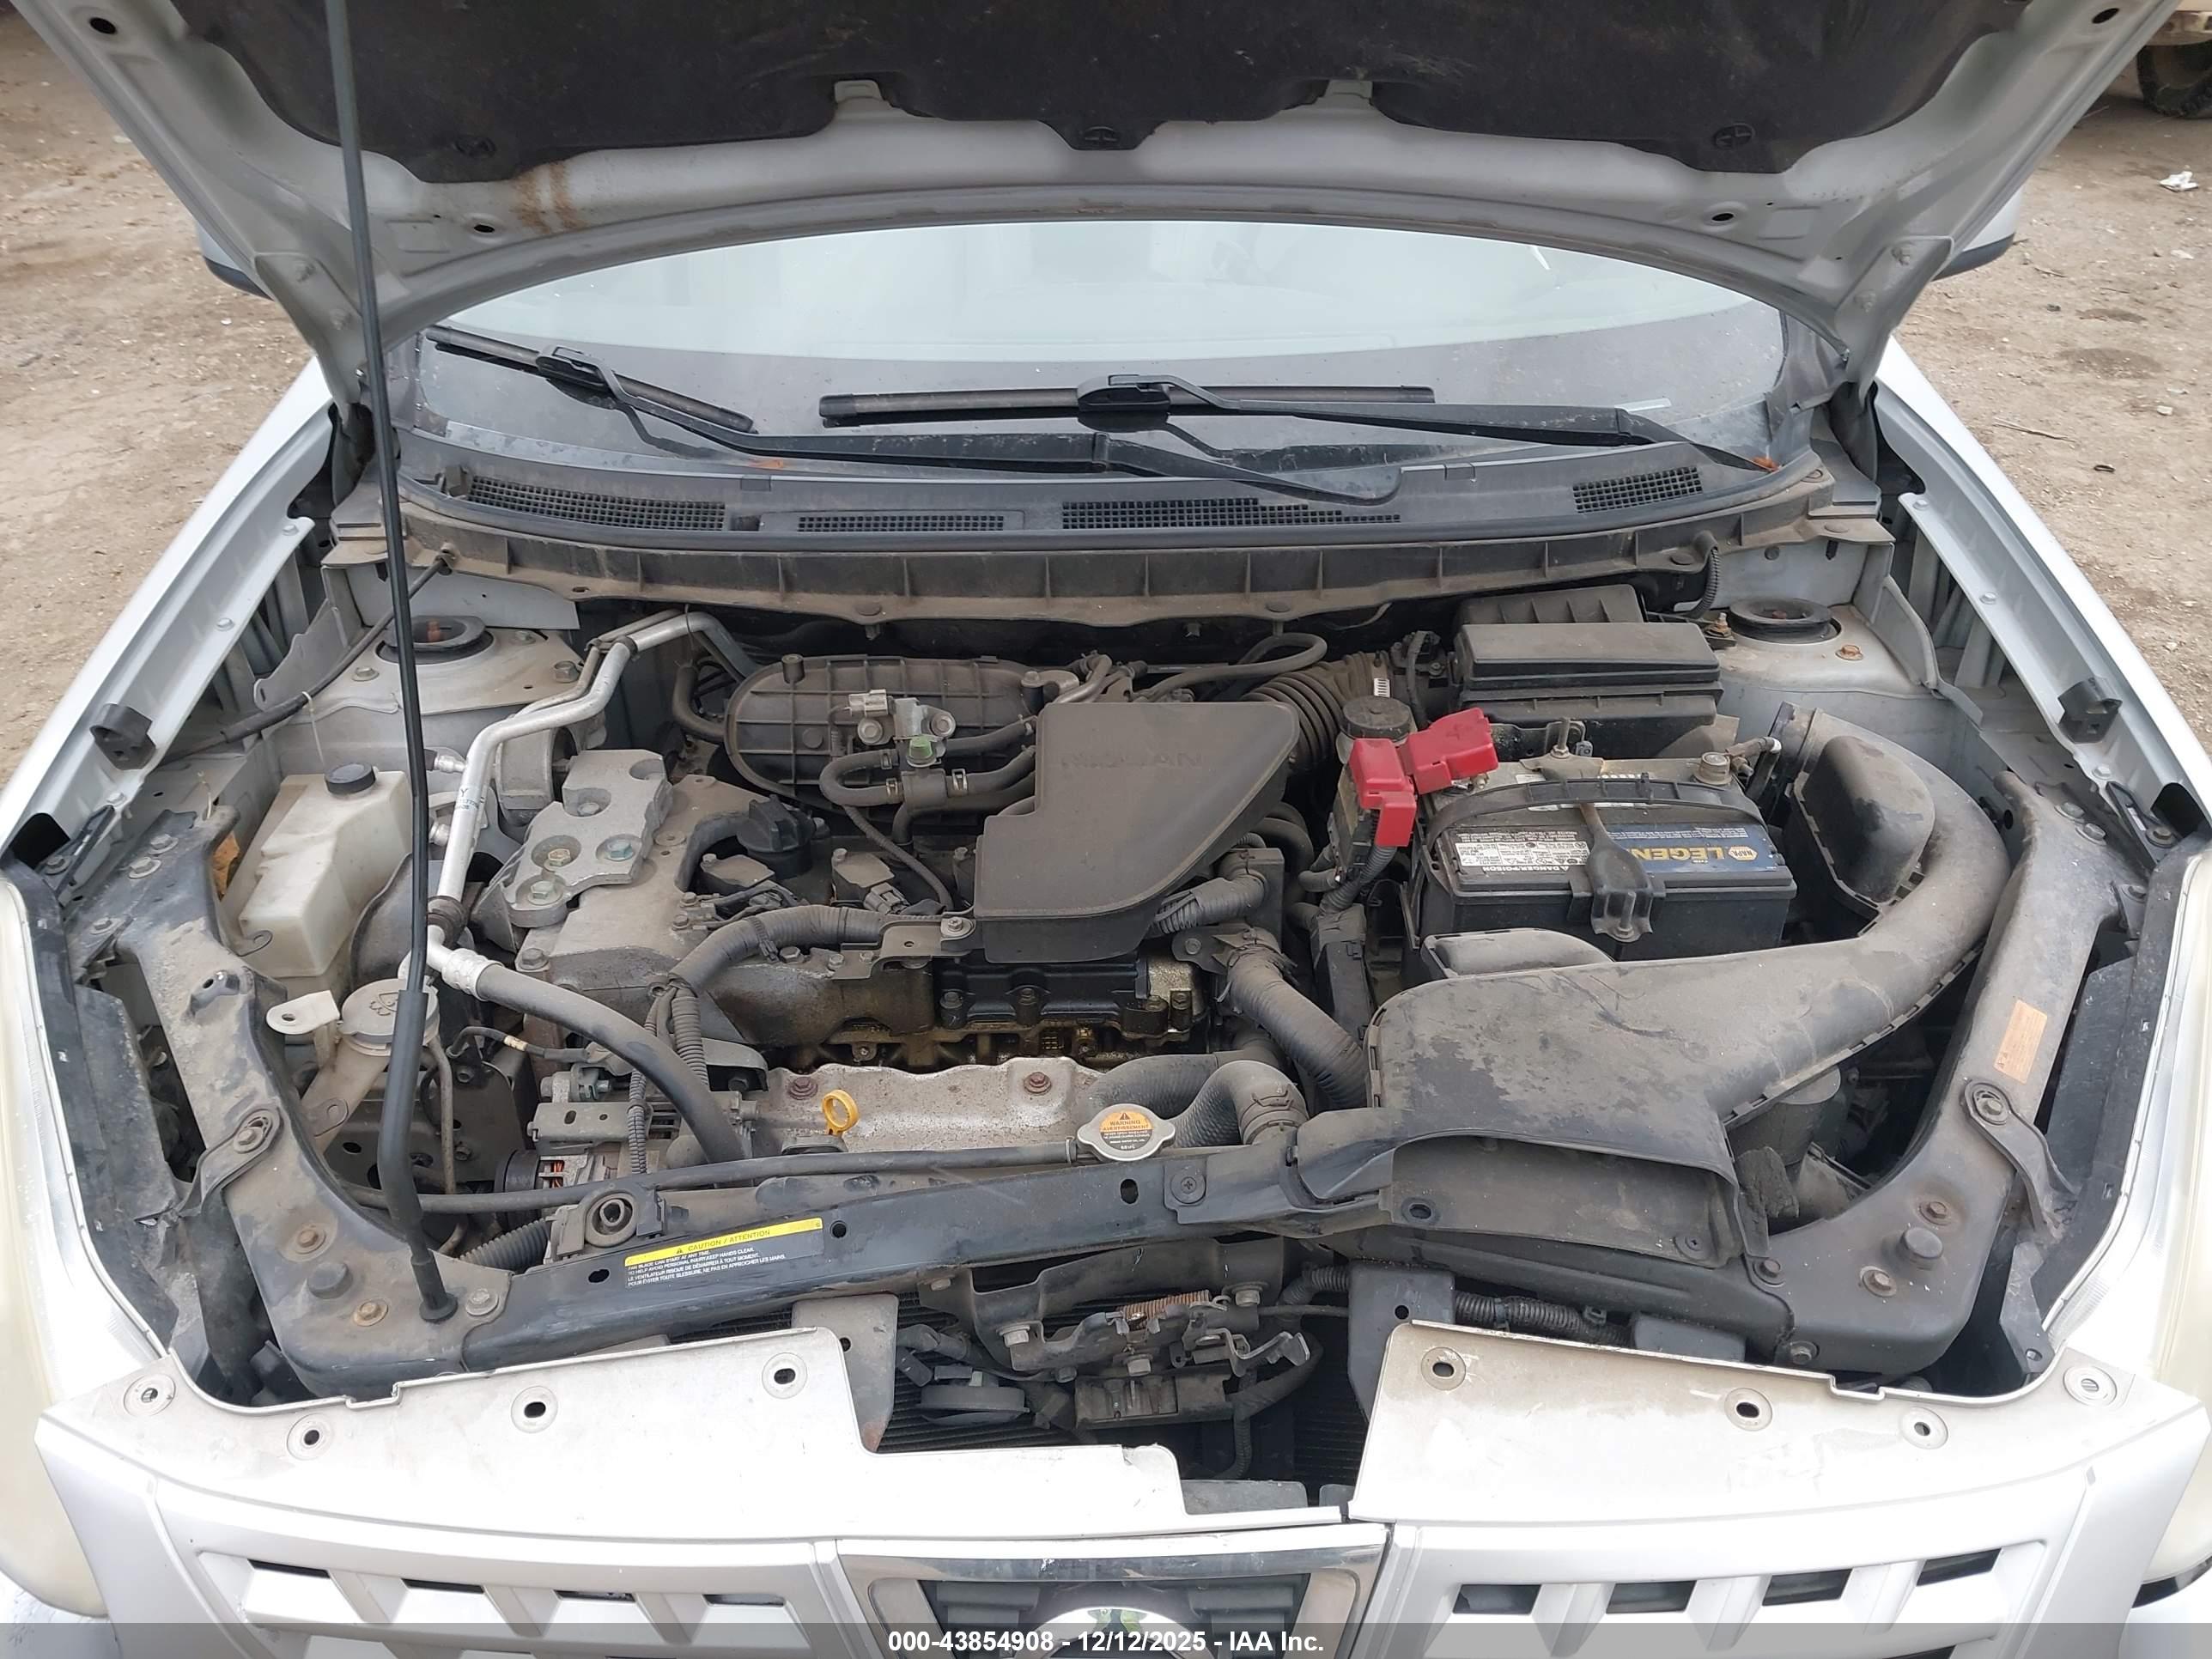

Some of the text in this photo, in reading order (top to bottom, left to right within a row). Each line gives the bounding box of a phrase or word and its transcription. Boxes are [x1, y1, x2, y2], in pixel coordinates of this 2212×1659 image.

[1628, 848, 1724, 861] LEGEN
[688, 1239, 721, 1252] CAUTION
[729, 1230, 770, 1243] ATTENTION
[635, 1270, 665, 1280] VENTILATEUR
[692, 1261, 720, 1269] DÉMARRER
[664, 1260, 690, 1268] PERSONAL
[728, 1259, 759, 1269] APPROCHER
